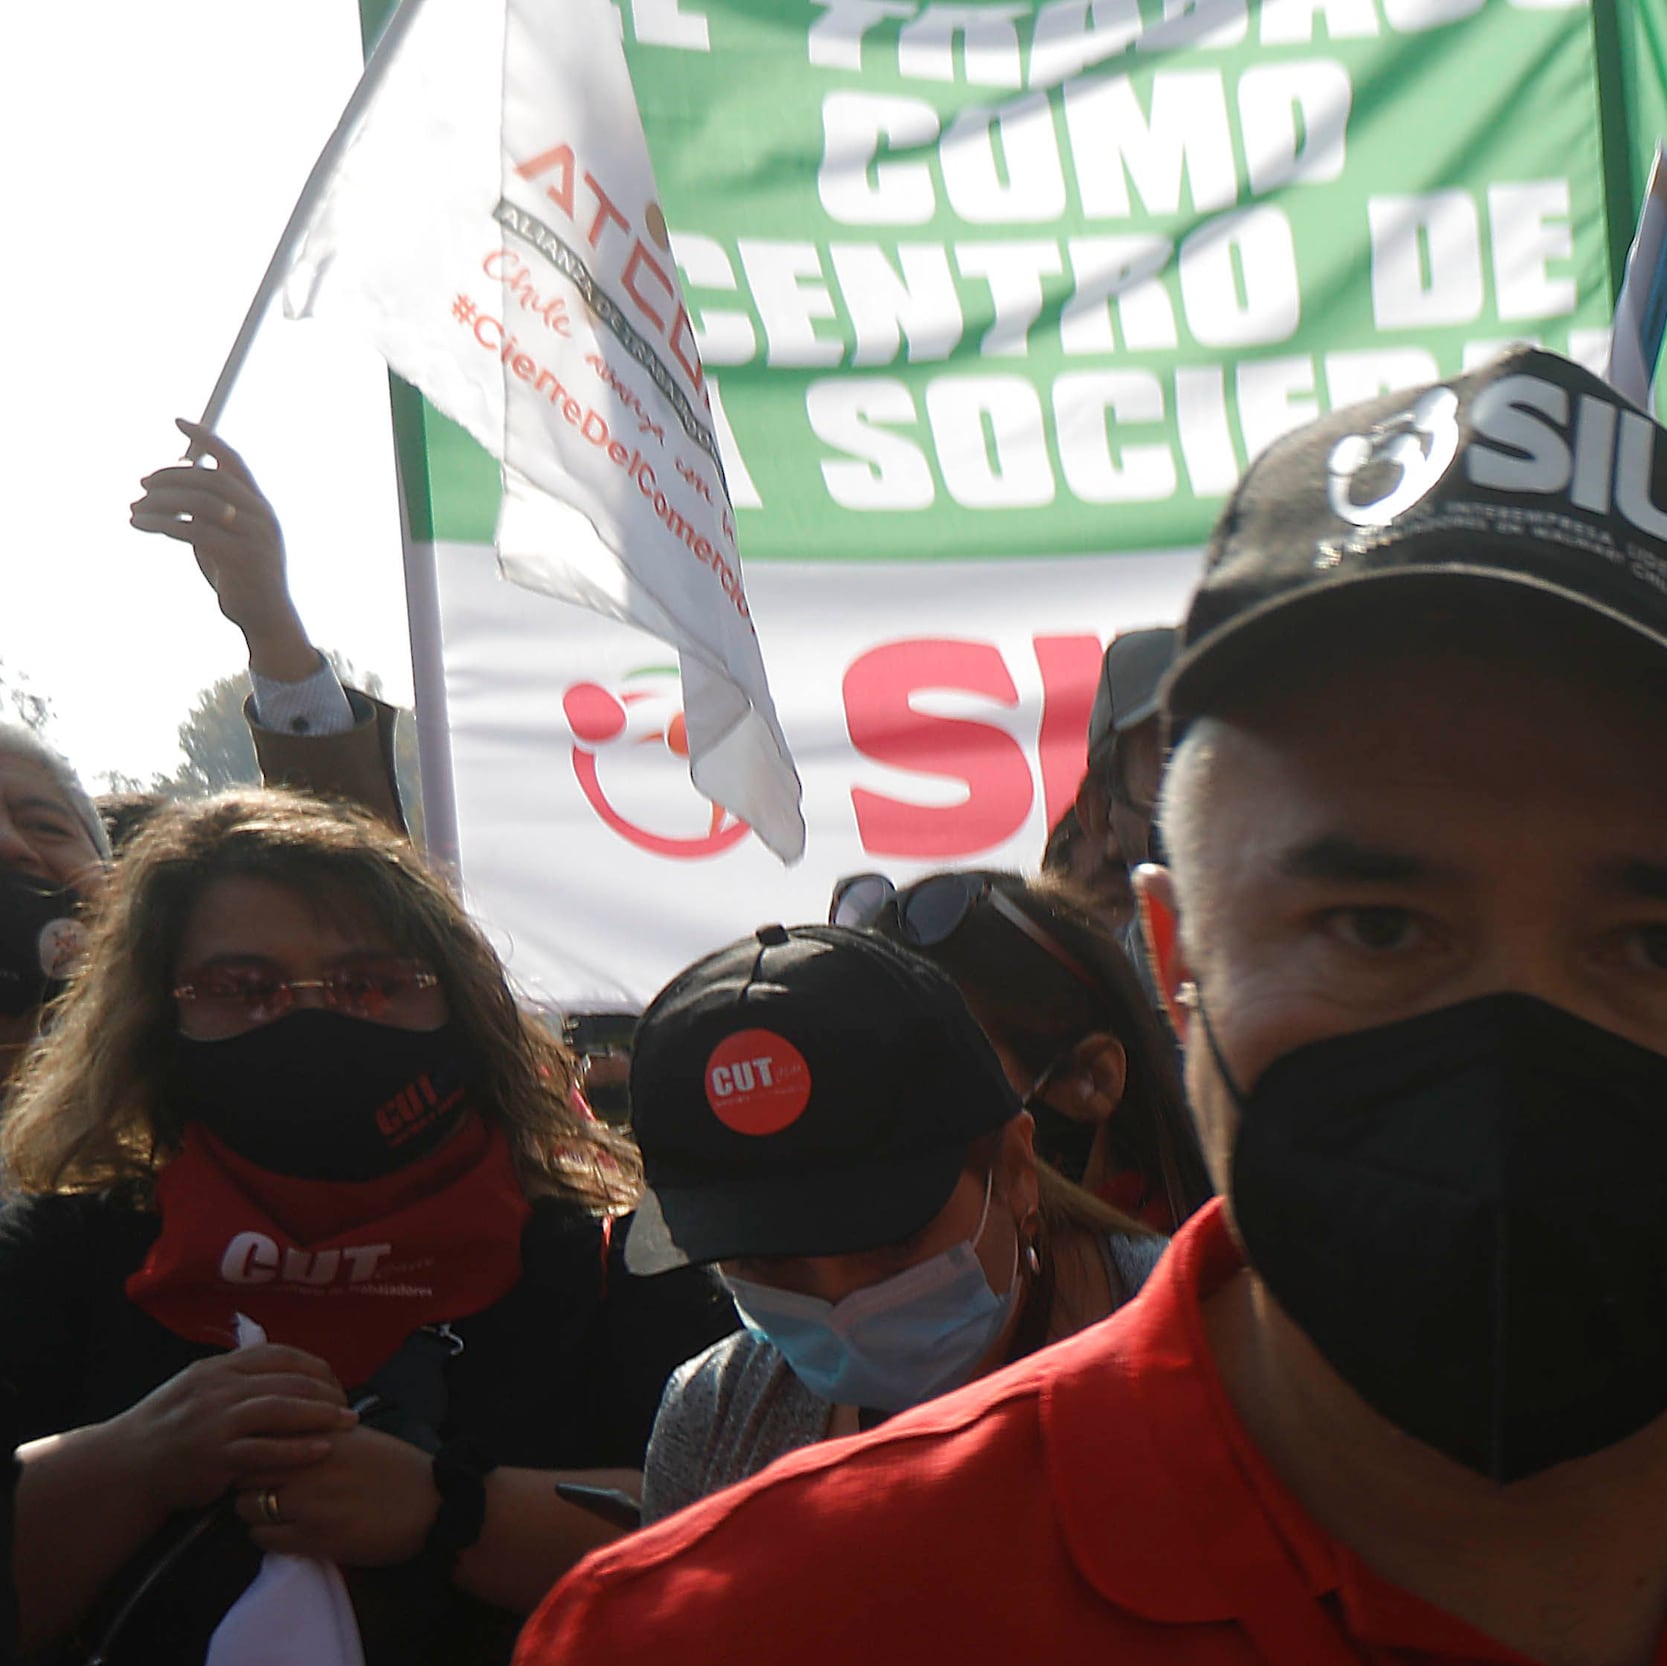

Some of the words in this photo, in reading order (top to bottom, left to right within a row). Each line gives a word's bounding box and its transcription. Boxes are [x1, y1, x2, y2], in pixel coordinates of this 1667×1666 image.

[820, 58, 1352, 228] COMO
[668, 205, 1300, 370] CENTRO
[1368, 178, 1577, 330] DE
[805, 330, 1560, 512] SOCIE
[711, 1056, 773, 1098] CUT
[219, 1230, 391, 1286] CUT
